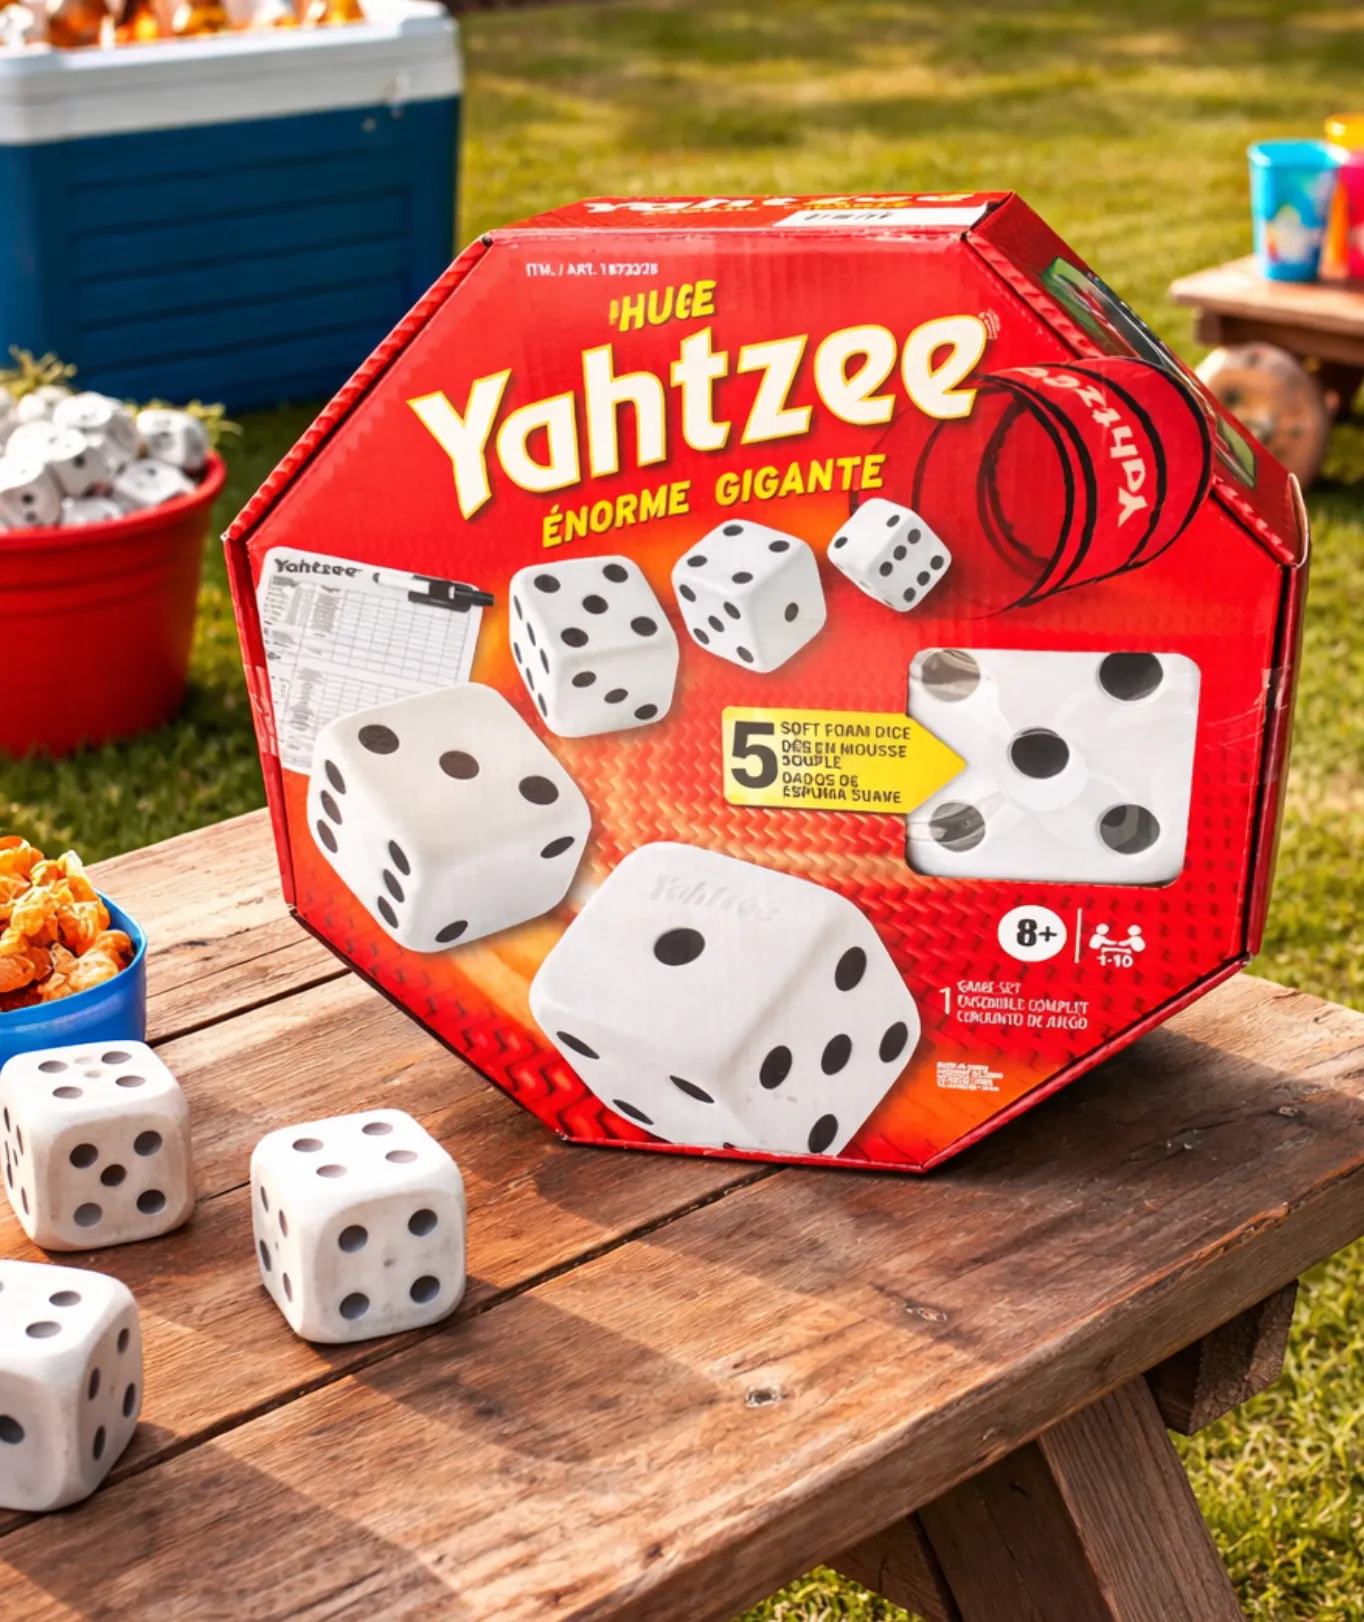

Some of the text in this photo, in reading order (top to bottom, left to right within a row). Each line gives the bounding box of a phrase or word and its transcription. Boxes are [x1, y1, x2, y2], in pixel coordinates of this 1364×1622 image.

[407, 314, 987, 520] Yahtzee
[541, 454, 886, 548] ÉNORME GIGANTE
[780, 721, 911, 740] SOFT FOAM DICE
[731, 720, 778, 789] 5
[782, 771, 835, 787] DADOS
[852, 789, 902, 804] SUAVE
[1016, 918, 1058, 947] 8+
[938, 986, 951, 1015] 1
